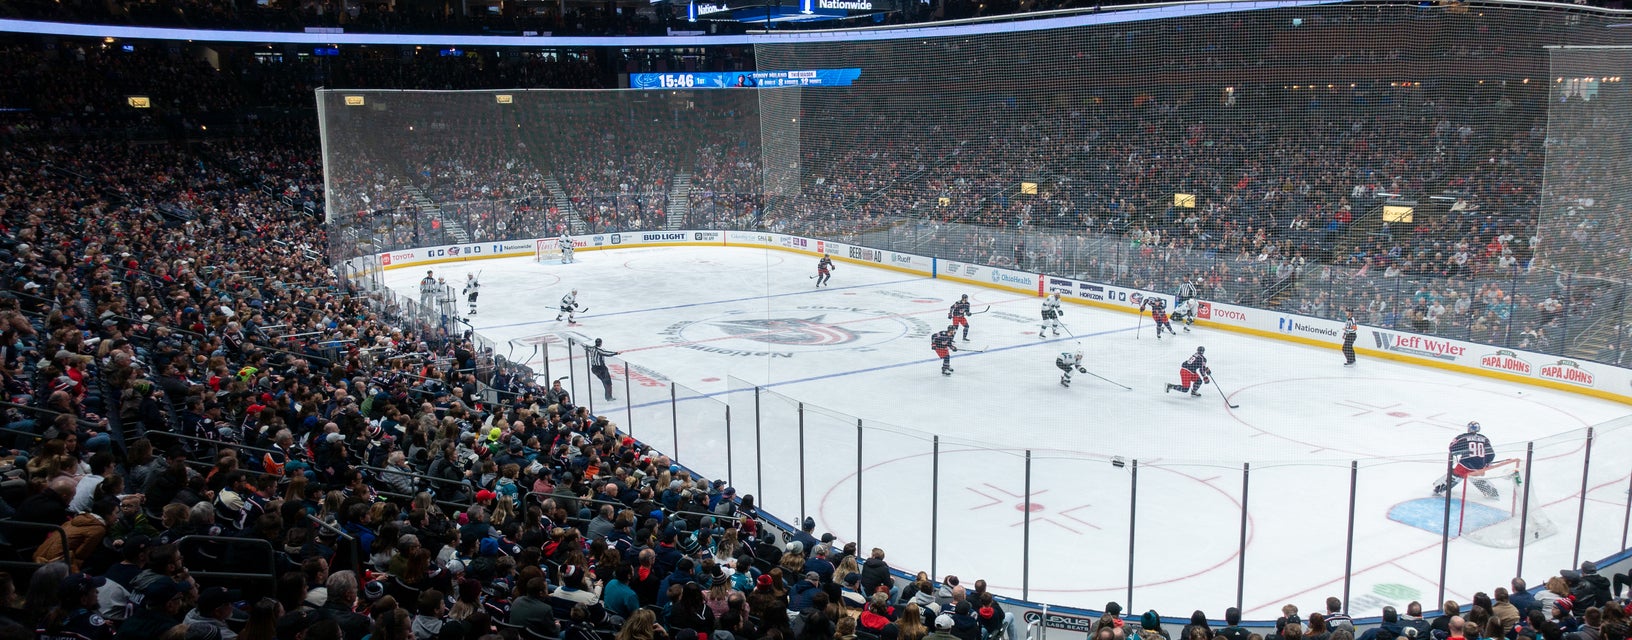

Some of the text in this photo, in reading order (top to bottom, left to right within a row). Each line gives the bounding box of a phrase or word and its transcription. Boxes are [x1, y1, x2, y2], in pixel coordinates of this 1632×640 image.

[698, 5, 728, 15] Nation
[819, 0, 872, 10] Nationwide
[659, 74, 694, 87] 15:46
[392, 253, 415, 261] TOYOTA
[849, 246, 862, 259] BEER
[1001, 274, 1032, 286] OhioHealth
[1079, 291, 1104, 301] HORIZON
[1213, 309, 1246, 321] TOYOTA
[1294, 322, 1338, 337] Nationwide
[1395, 335, 1422, 349] Jeff
[1423, 339, 1466, 357] Wyler
[1482, 356, 1500, 367] PAPA
[1541, 367, 1562, 379] PAPA
[1469, 442, 1486, 457] 90
[1067, 624, 1089, 632] SEATS
